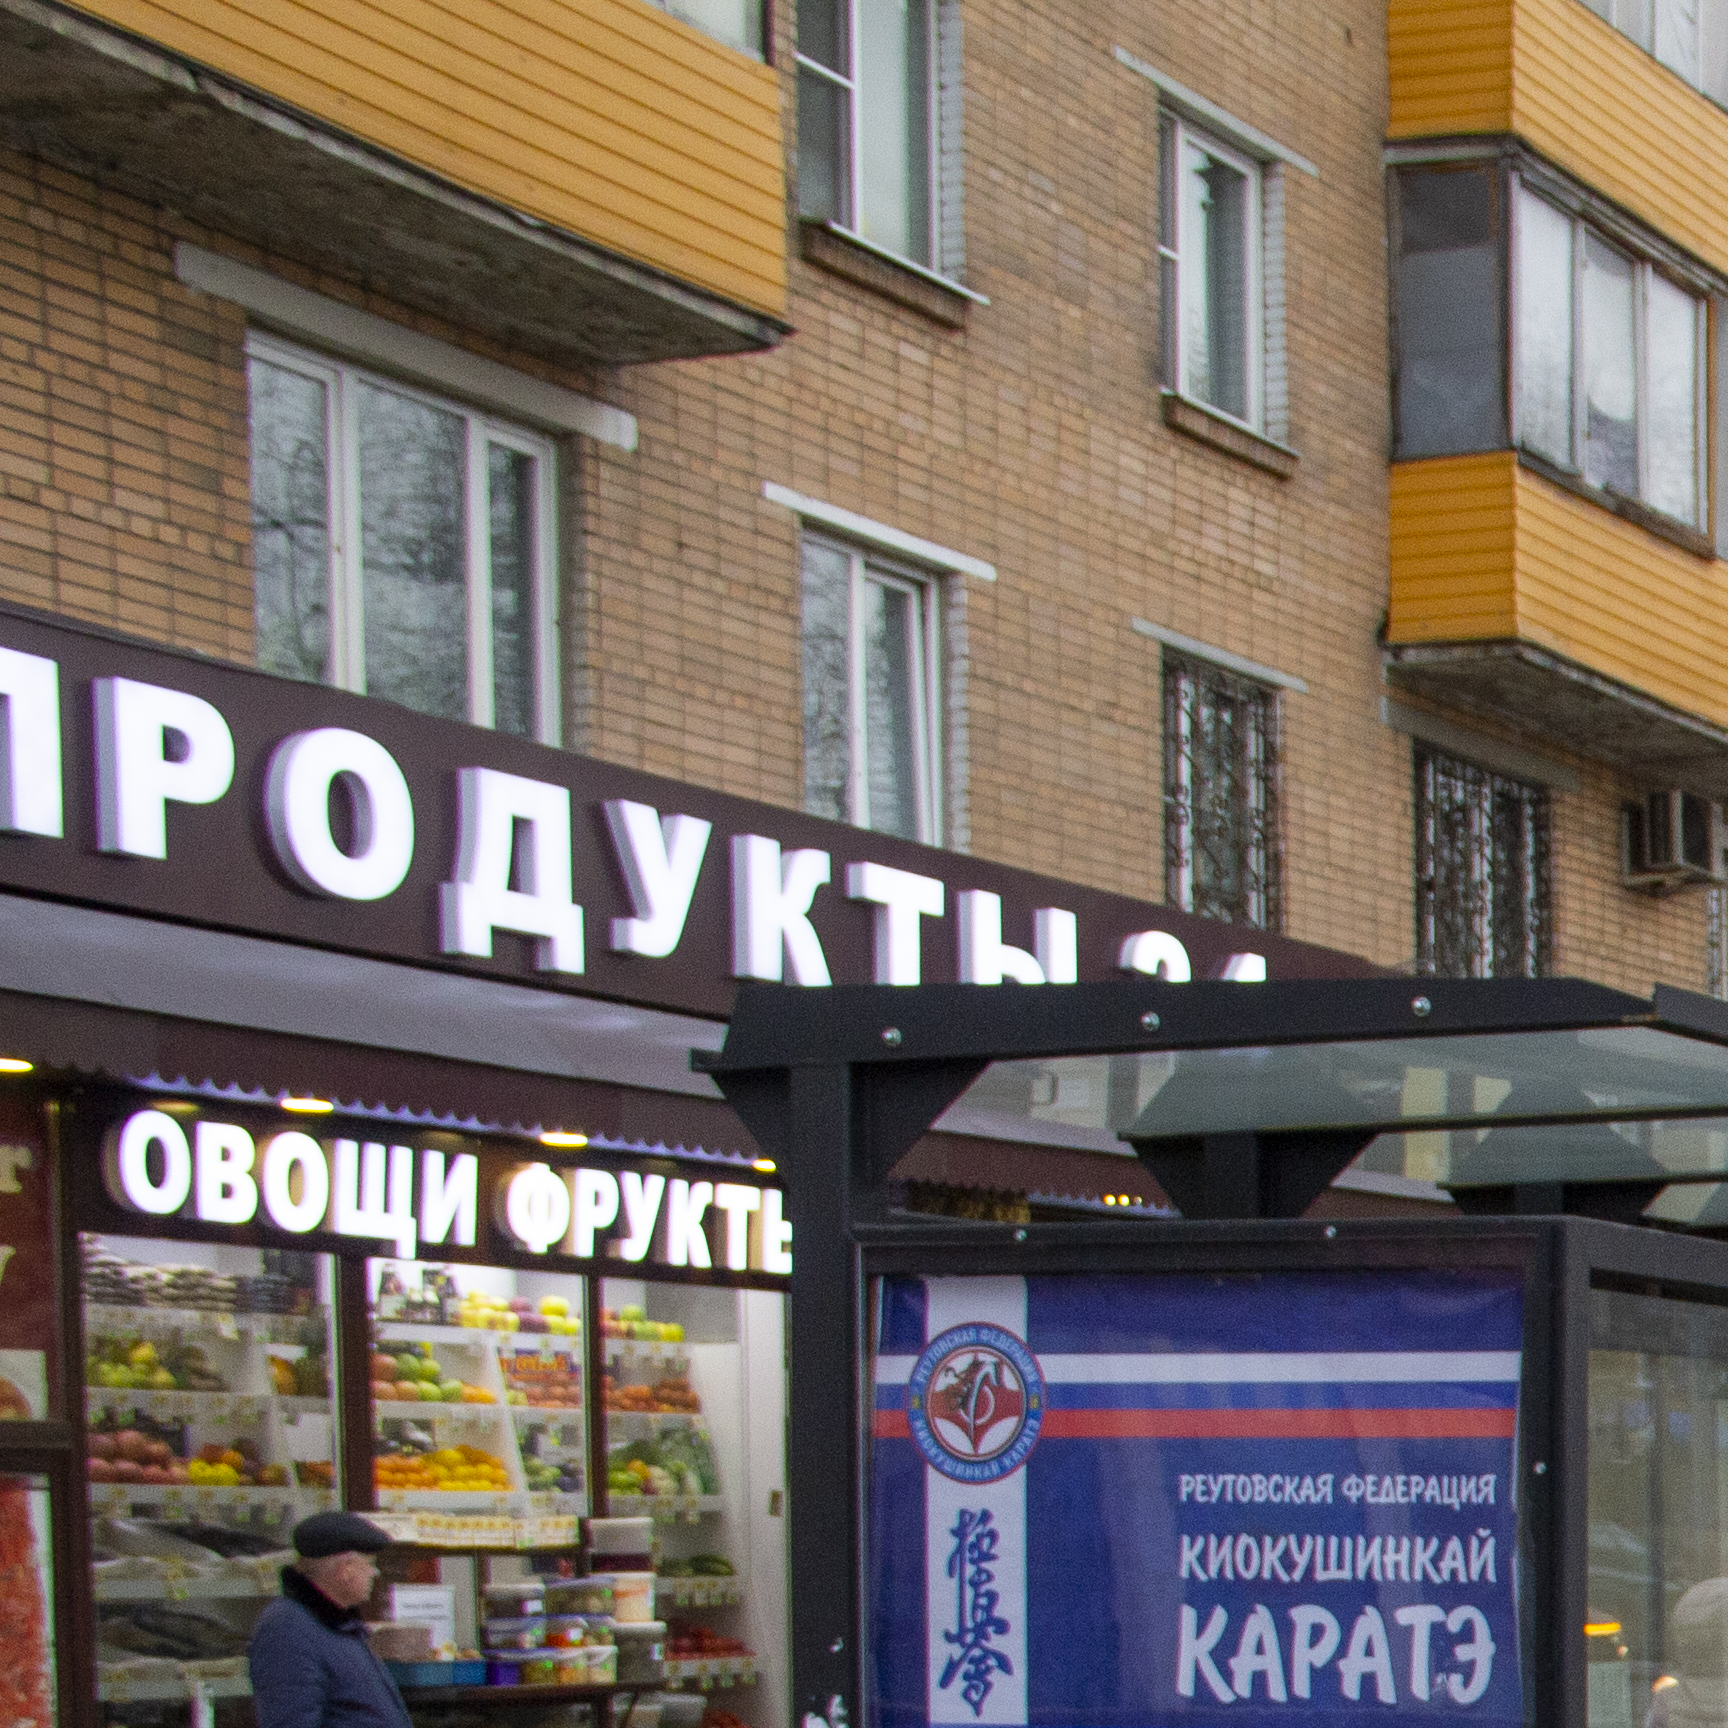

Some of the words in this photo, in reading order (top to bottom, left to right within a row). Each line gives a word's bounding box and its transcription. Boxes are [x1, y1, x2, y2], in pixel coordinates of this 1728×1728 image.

[110, 1108, 480, 1260] ОВОЩИ
[1178, 1474, 1334, 1504] РЕУТОВСКАЯ
[1341, 1474, 1498, 1511] ФЕДЕРАЦИЯ
[1178, 1527, 1497, 1583] КИОКУШИНКАЙ
[1175, 1603, 1496, 1704] КАРАТЭ
